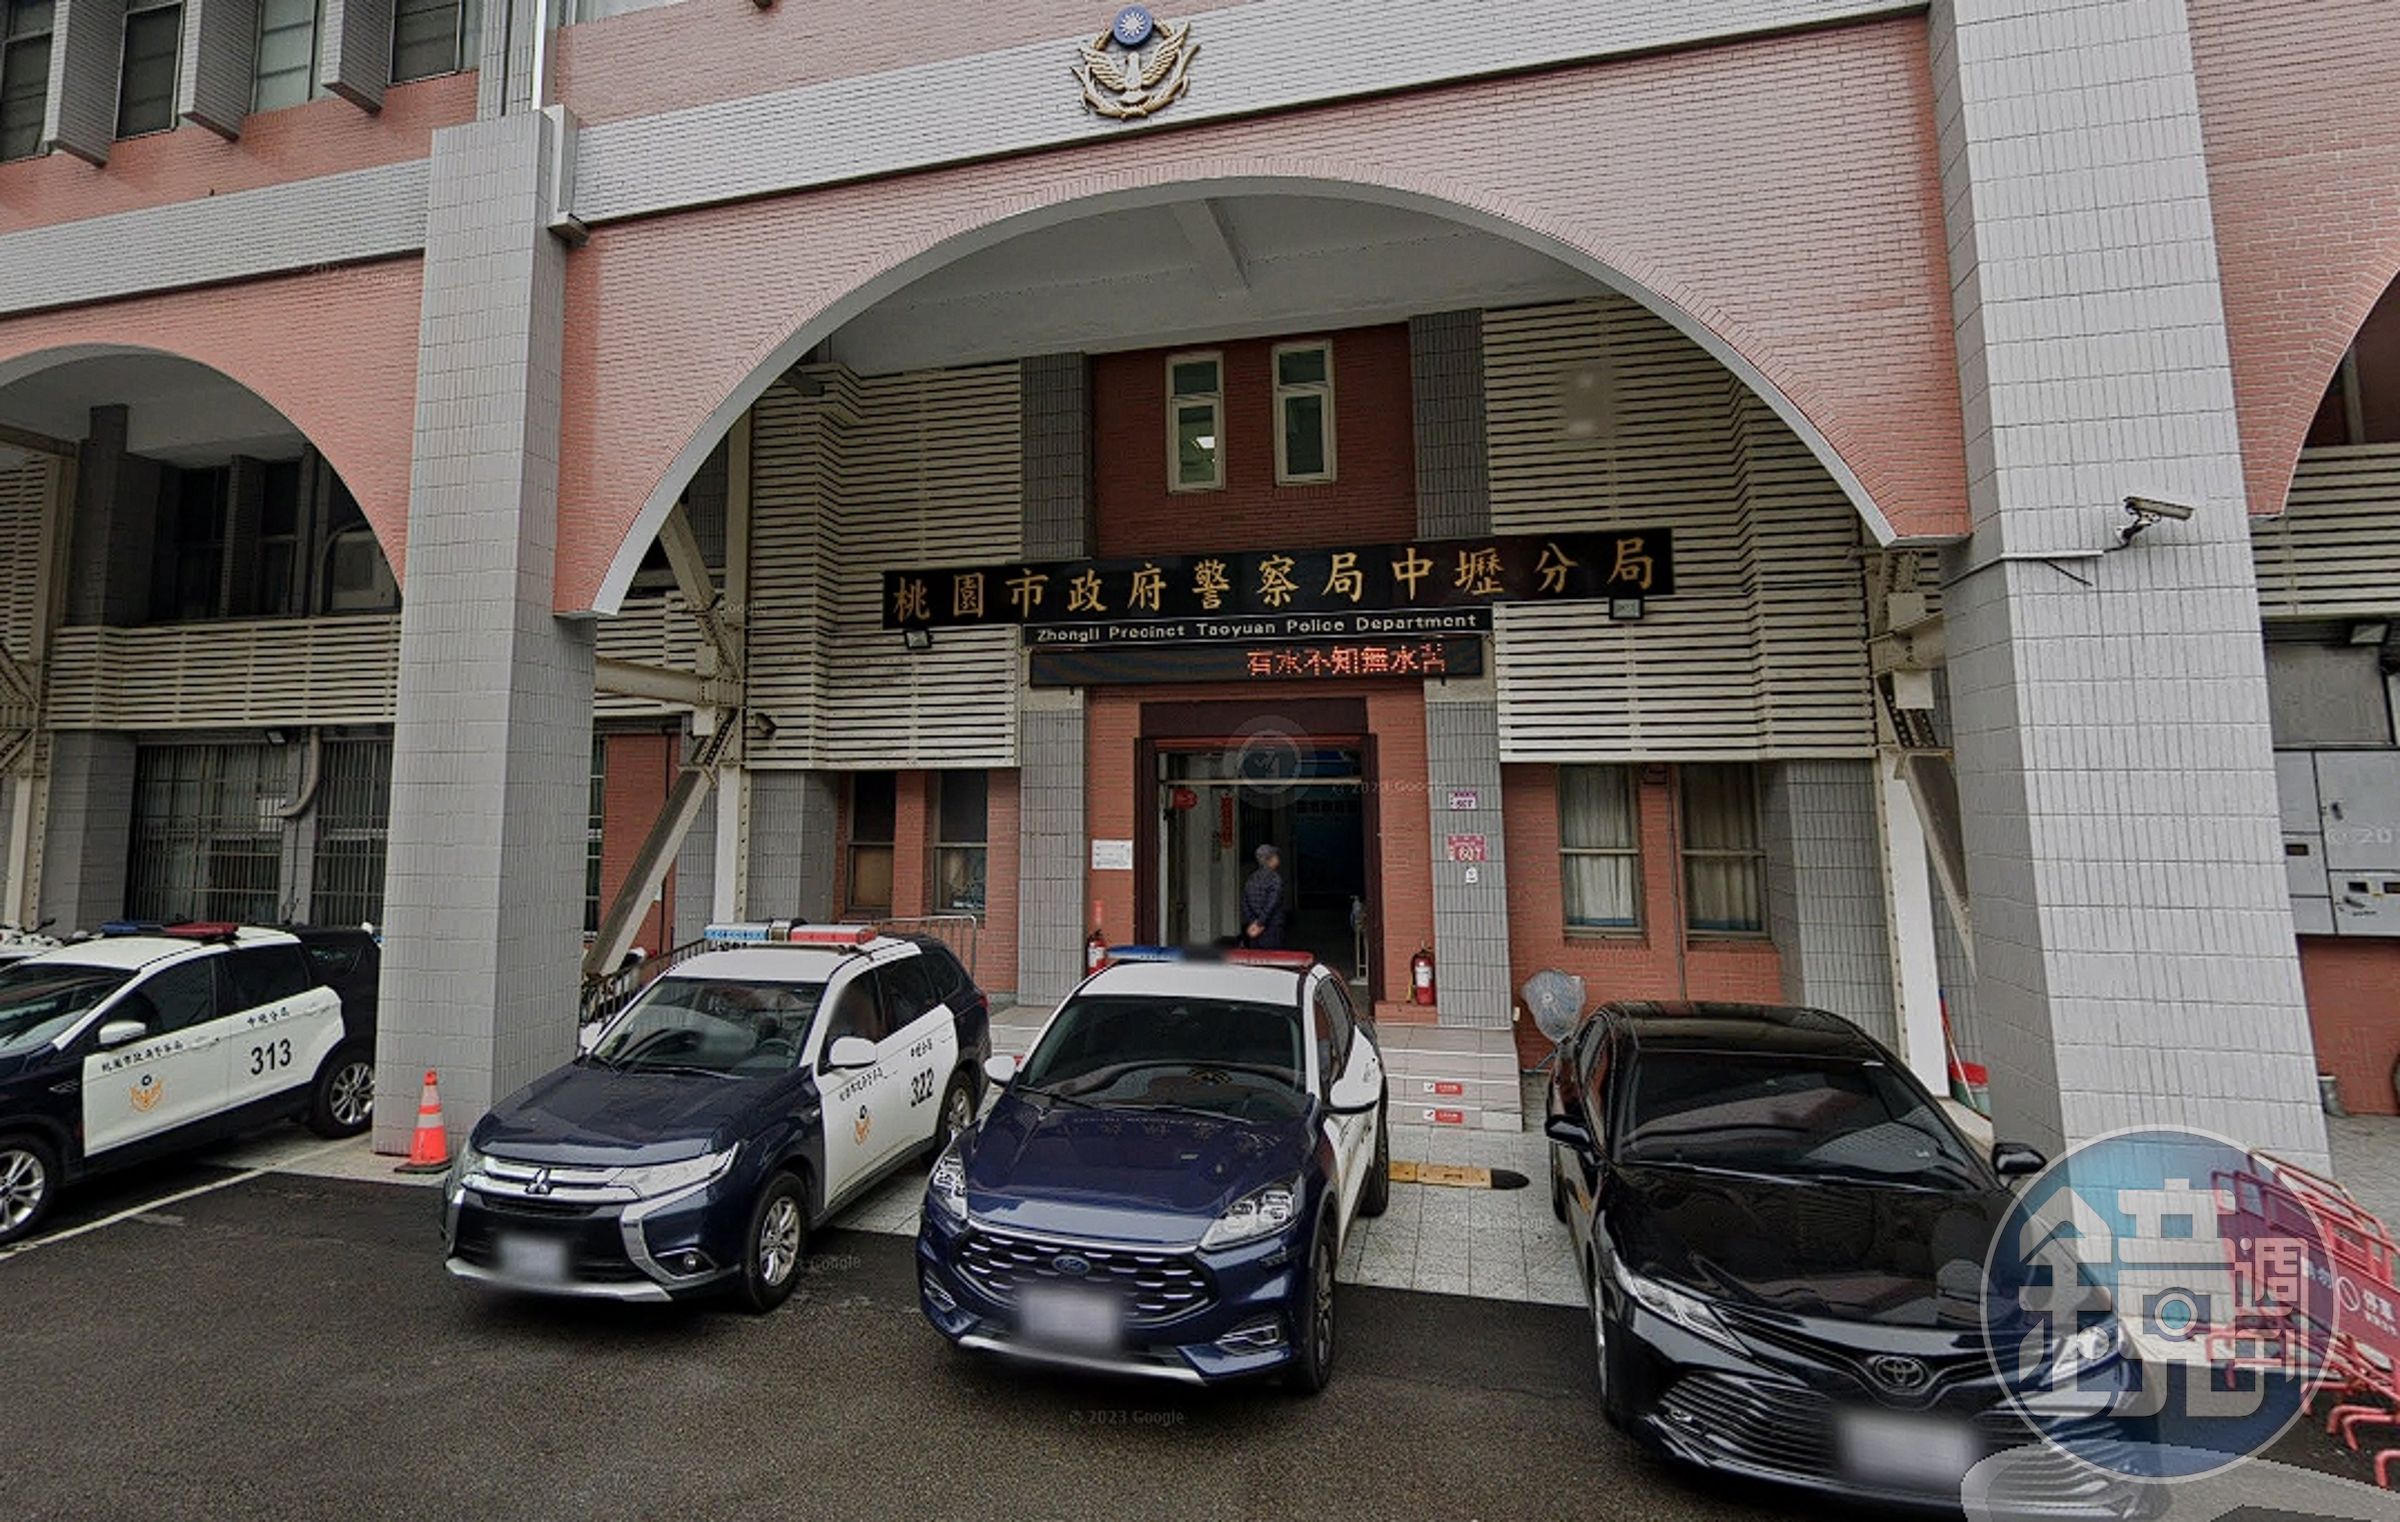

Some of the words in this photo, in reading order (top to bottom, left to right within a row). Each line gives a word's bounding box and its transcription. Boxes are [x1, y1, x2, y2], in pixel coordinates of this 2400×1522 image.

[893, 536, 1655, 623] 桃園市政府警察局中壢分局
[1036, 626, 1100, 643] Zhongli
[1109, 625, 1186, 640] Precinct
[1196, 622, 1276, 638] Taoyuan
[1286, 619, 1345, 633] Police
[1356, 614, 1477, 632] Department
[250, 1038, 292, 1076] 313
[910, 1067, 935, 1108] 322
